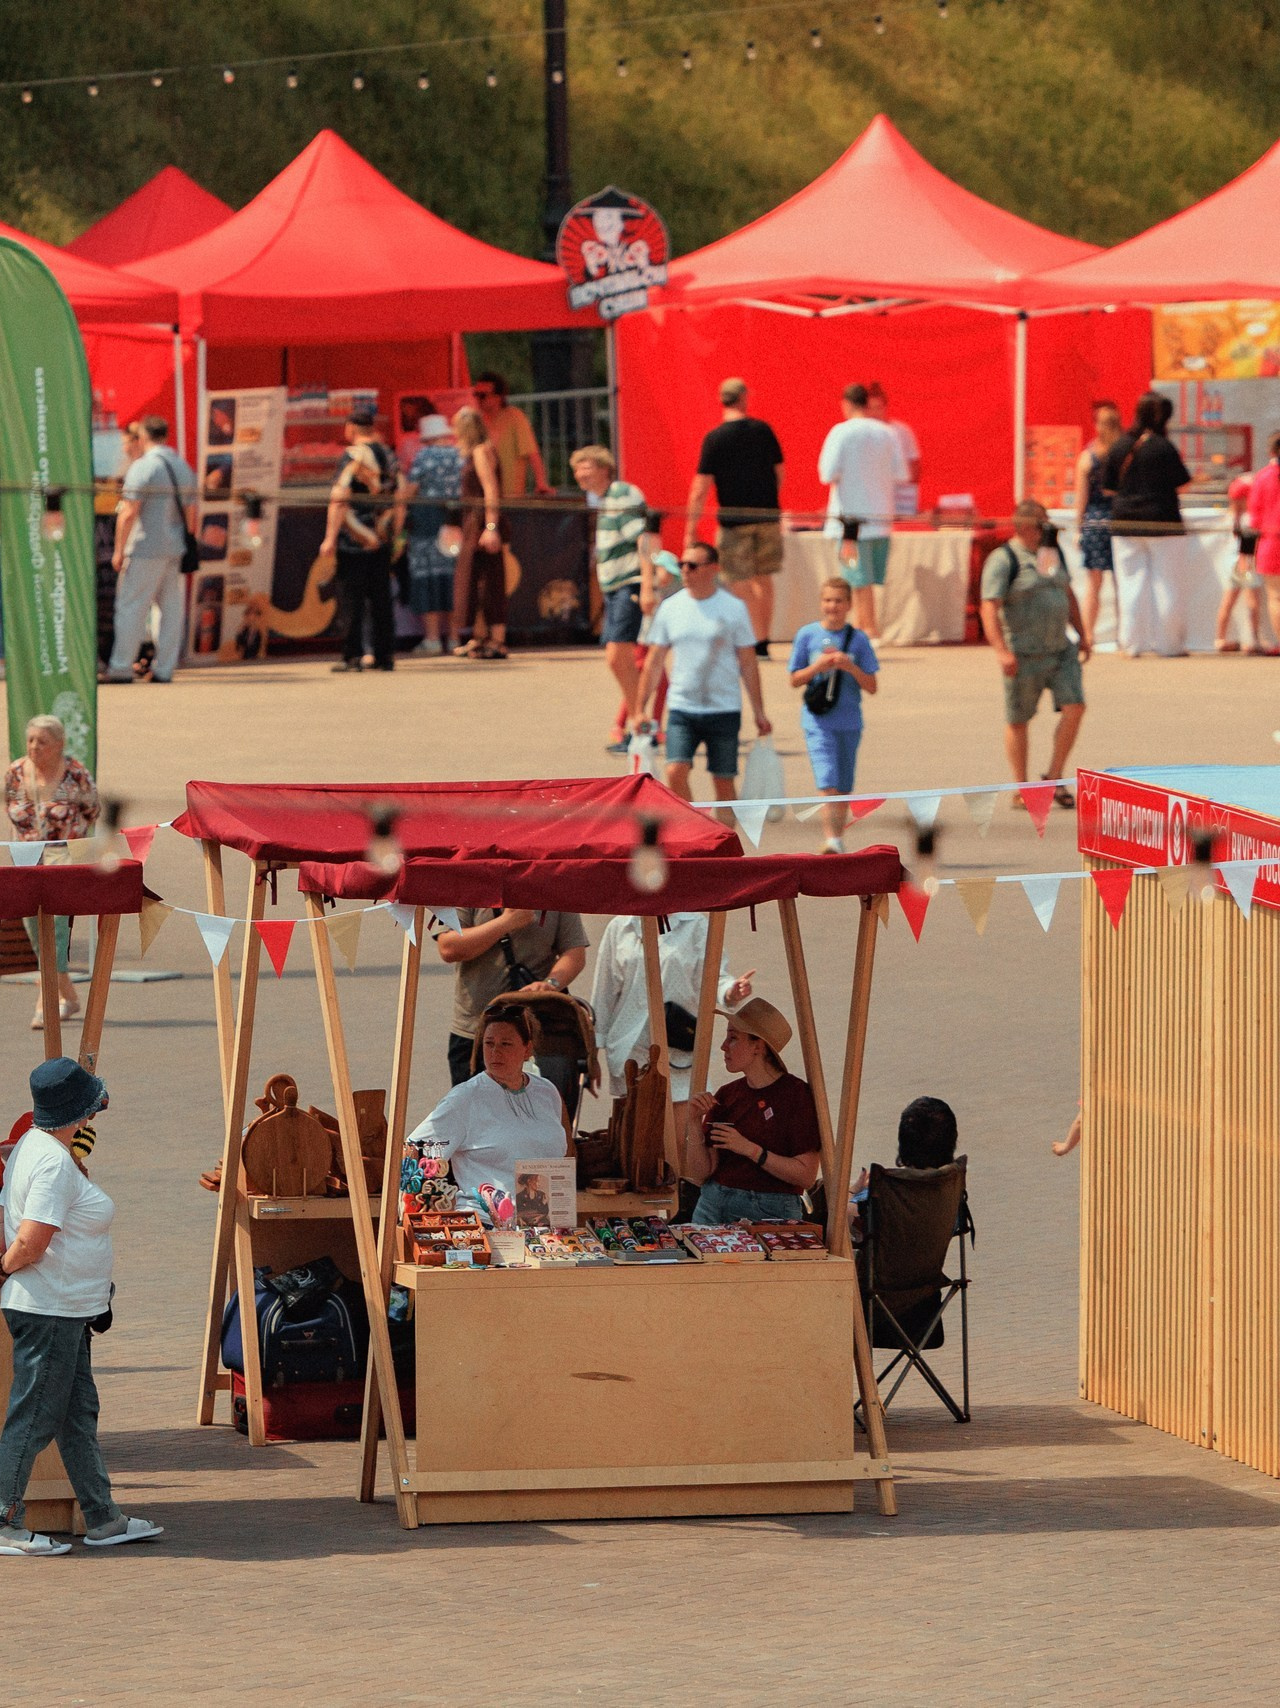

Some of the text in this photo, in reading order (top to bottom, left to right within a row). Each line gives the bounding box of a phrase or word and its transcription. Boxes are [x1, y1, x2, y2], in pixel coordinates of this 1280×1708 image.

[1102, 797, 1164, 850] ВКУСЫ РОССИИ
[1232, 832, 1259, 878] ВКУСЫ
